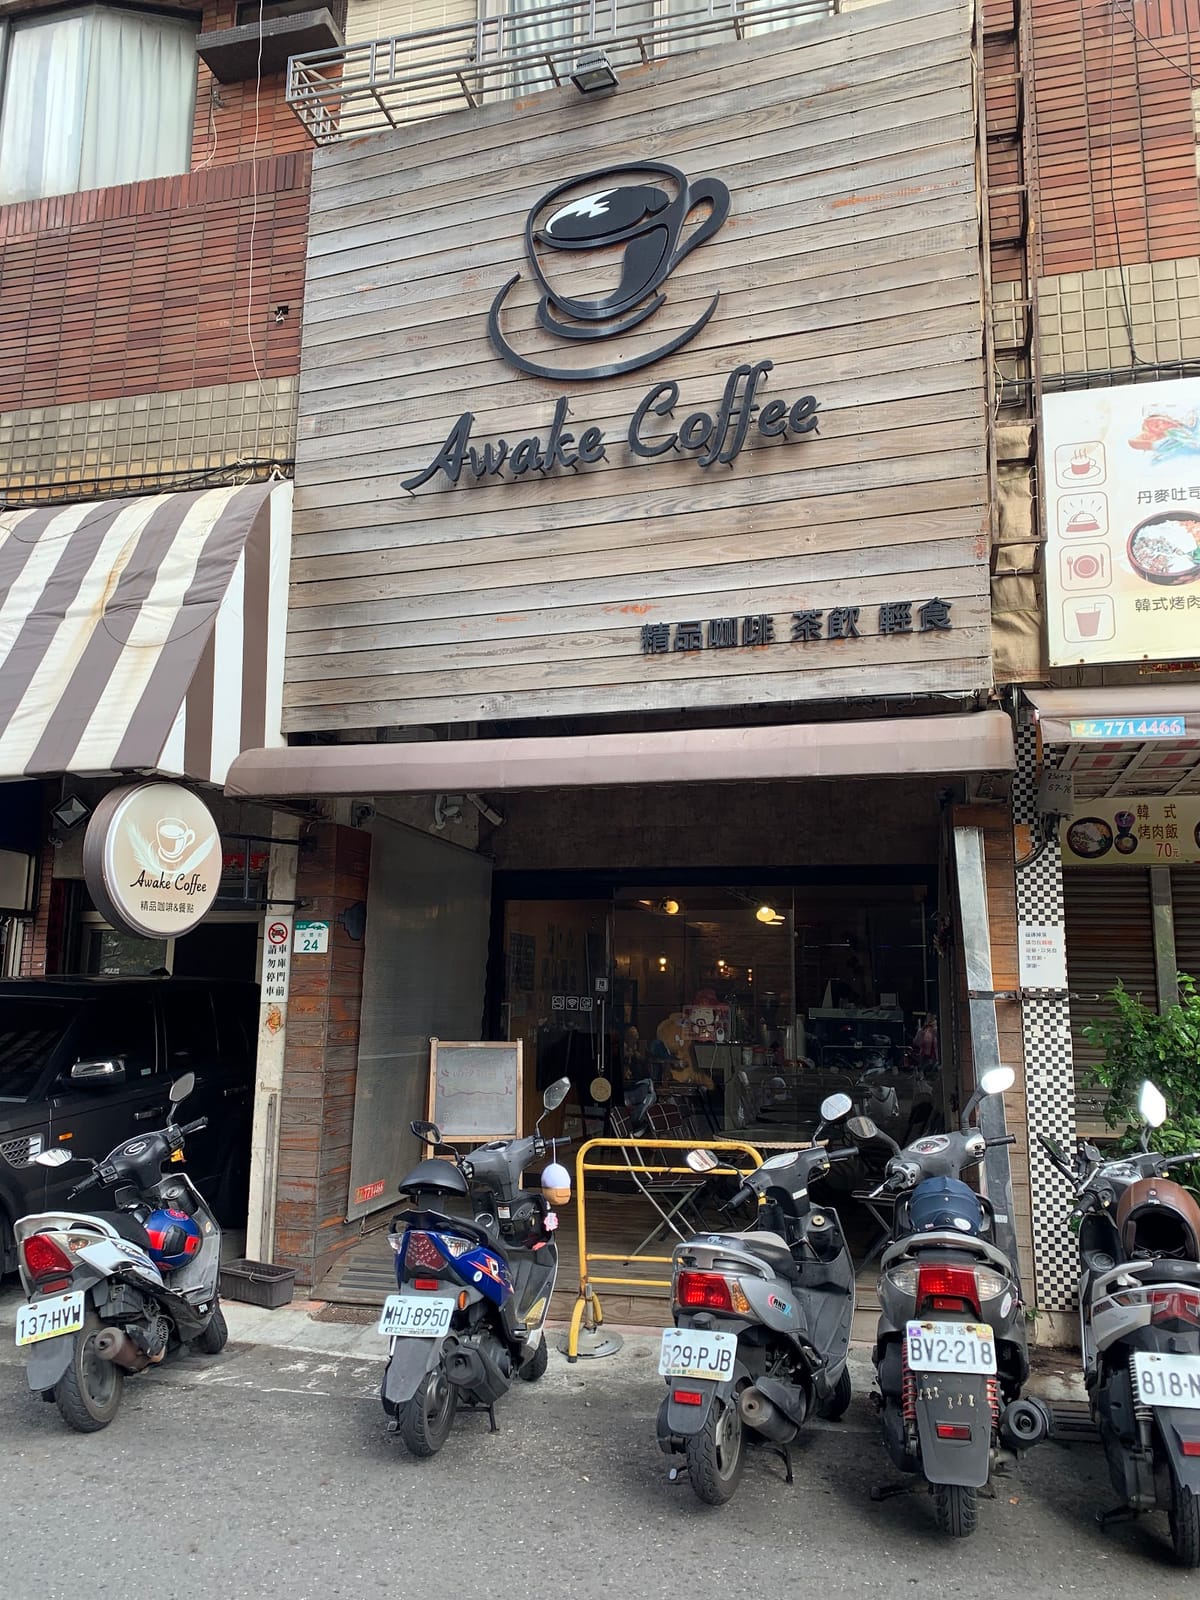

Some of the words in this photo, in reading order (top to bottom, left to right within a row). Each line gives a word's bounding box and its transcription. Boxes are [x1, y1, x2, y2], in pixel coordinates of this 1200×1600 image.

[401, 396, 606, 491] Awake
[627, 360, 821, 468] Coffee
[1137, 486, 1200, 504] 丹麥吐司
[1135, 595, 1200, 613] 韓式烤肉
[640, 614, 774, 654] 精品咖啡
[791, 607, 861, 641] 茶飲
[879, 597, 953, 634] 輕食
[1104, 720, 1181, 735] 7714466
[1138, 824, 1178, 840] 烤肉飯
[130, 870, 171, 889] Awake
[174, 873, 207, 895] Coffee
[303, 939, 319, 951] 24
